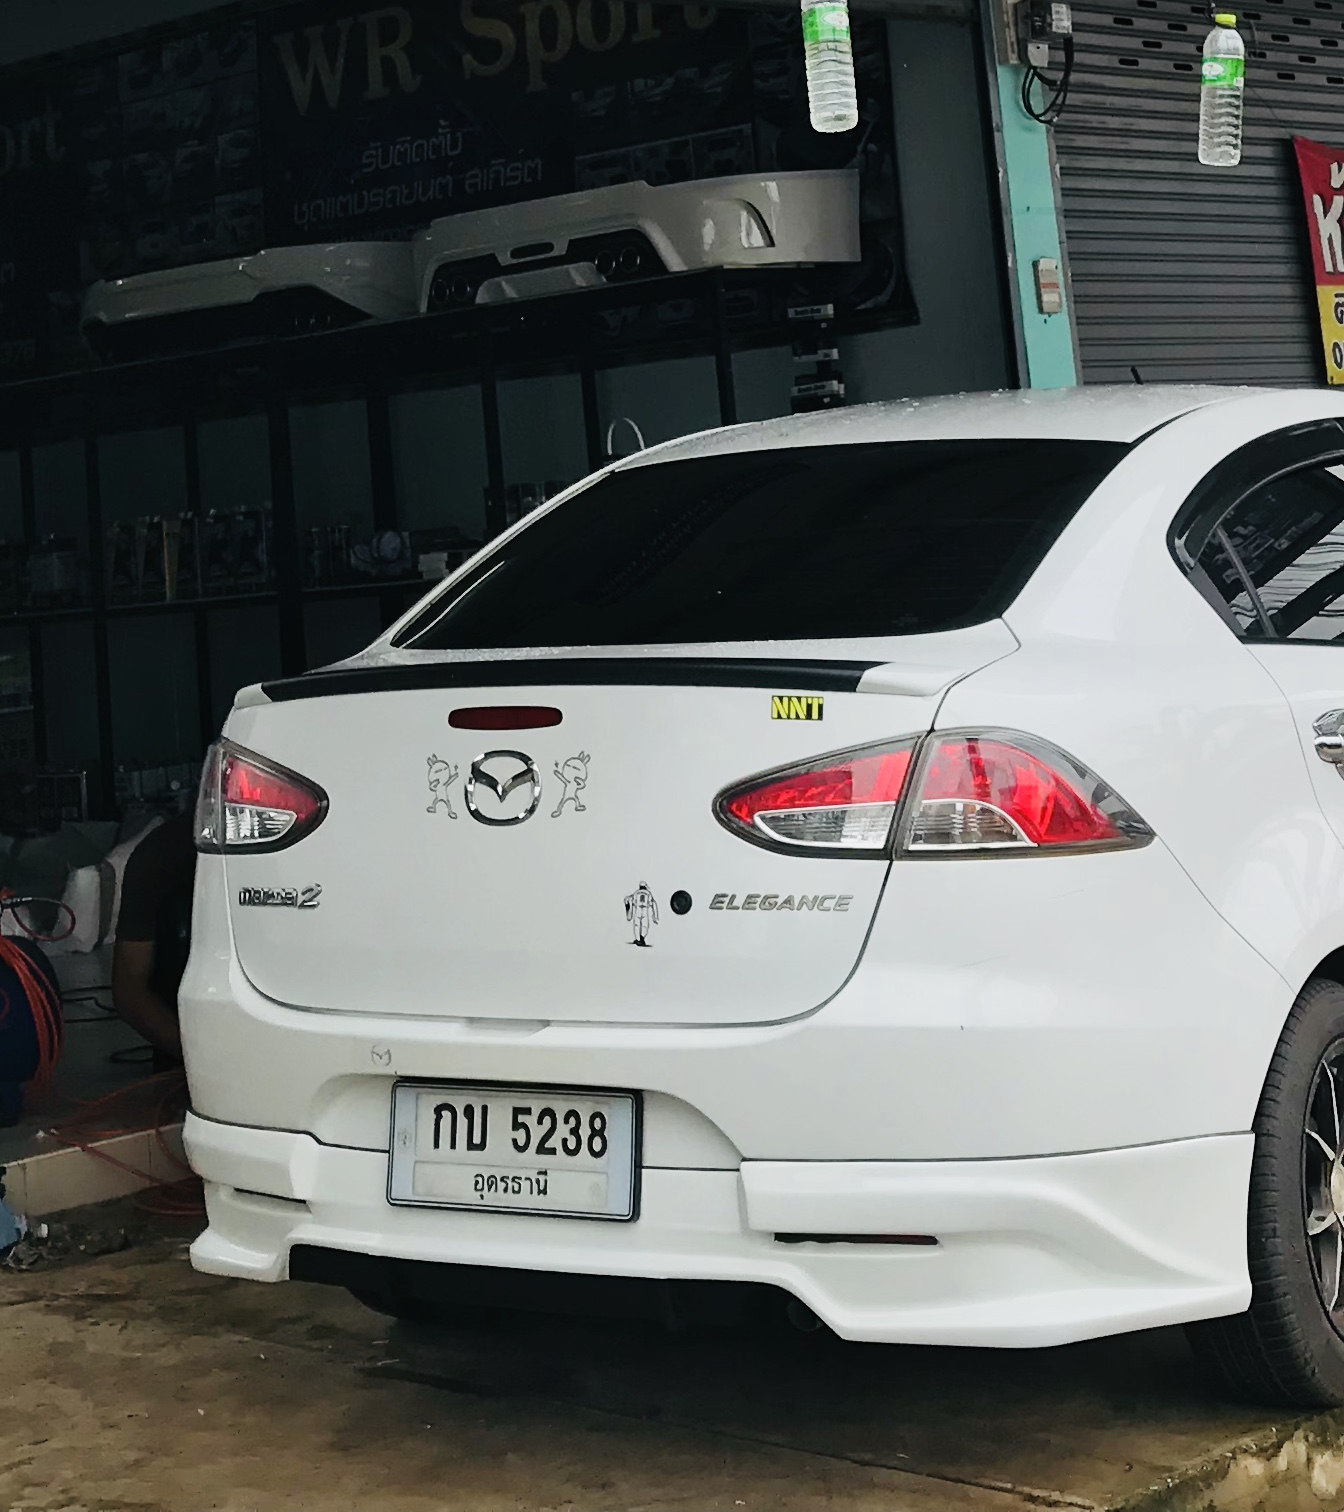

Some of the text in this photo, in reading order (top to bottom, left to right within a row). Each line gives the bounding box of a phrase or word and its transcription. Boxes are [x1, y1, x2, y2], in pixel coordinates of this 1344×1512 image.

[272, 5, 423, 117] WR
[771, 695, 824, 720] NNT
[709, 893, 854, 912] ELEGANCE
[433, 1102, 608, 1159] กบ 5238
[473, 1170, 549, 1200] อุดรธานี
